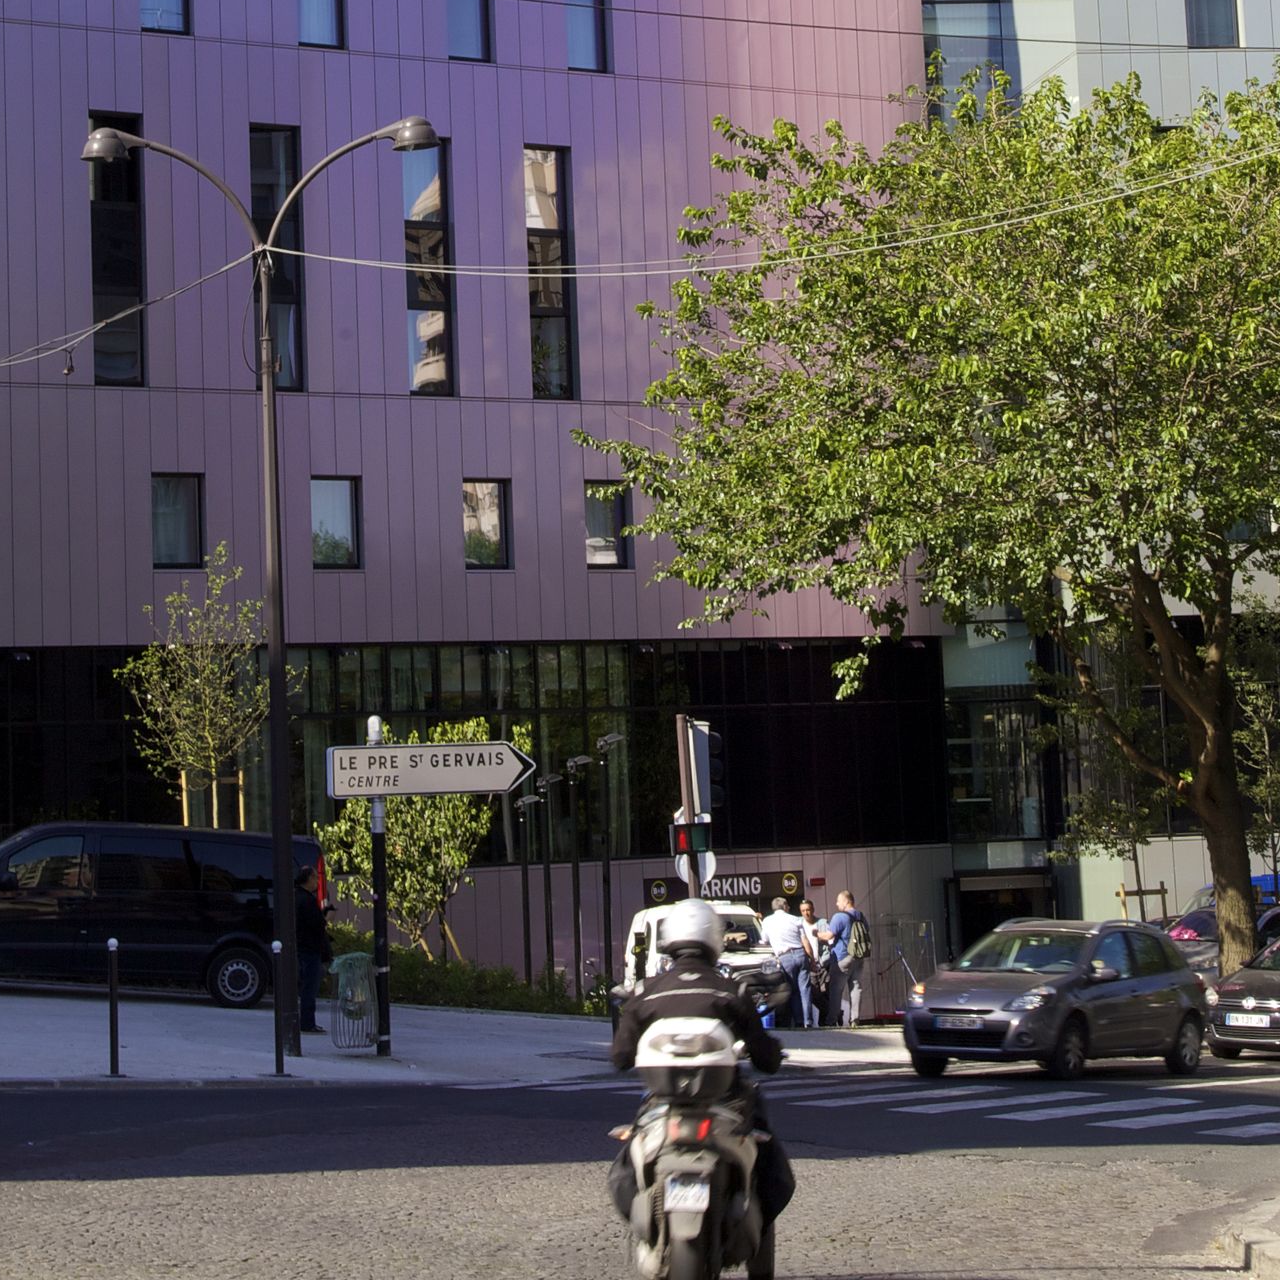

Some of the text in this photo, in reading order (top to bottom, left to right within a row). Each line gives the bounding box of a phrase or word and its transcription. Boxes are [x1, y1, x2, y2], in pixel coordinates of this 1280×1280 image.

[339, 756, 358, 771] LE
[368, 755, 399, 770] PRE
[430, 751, 505, 768] GERVAIS
[701, 876, 762, 898] ARKING
